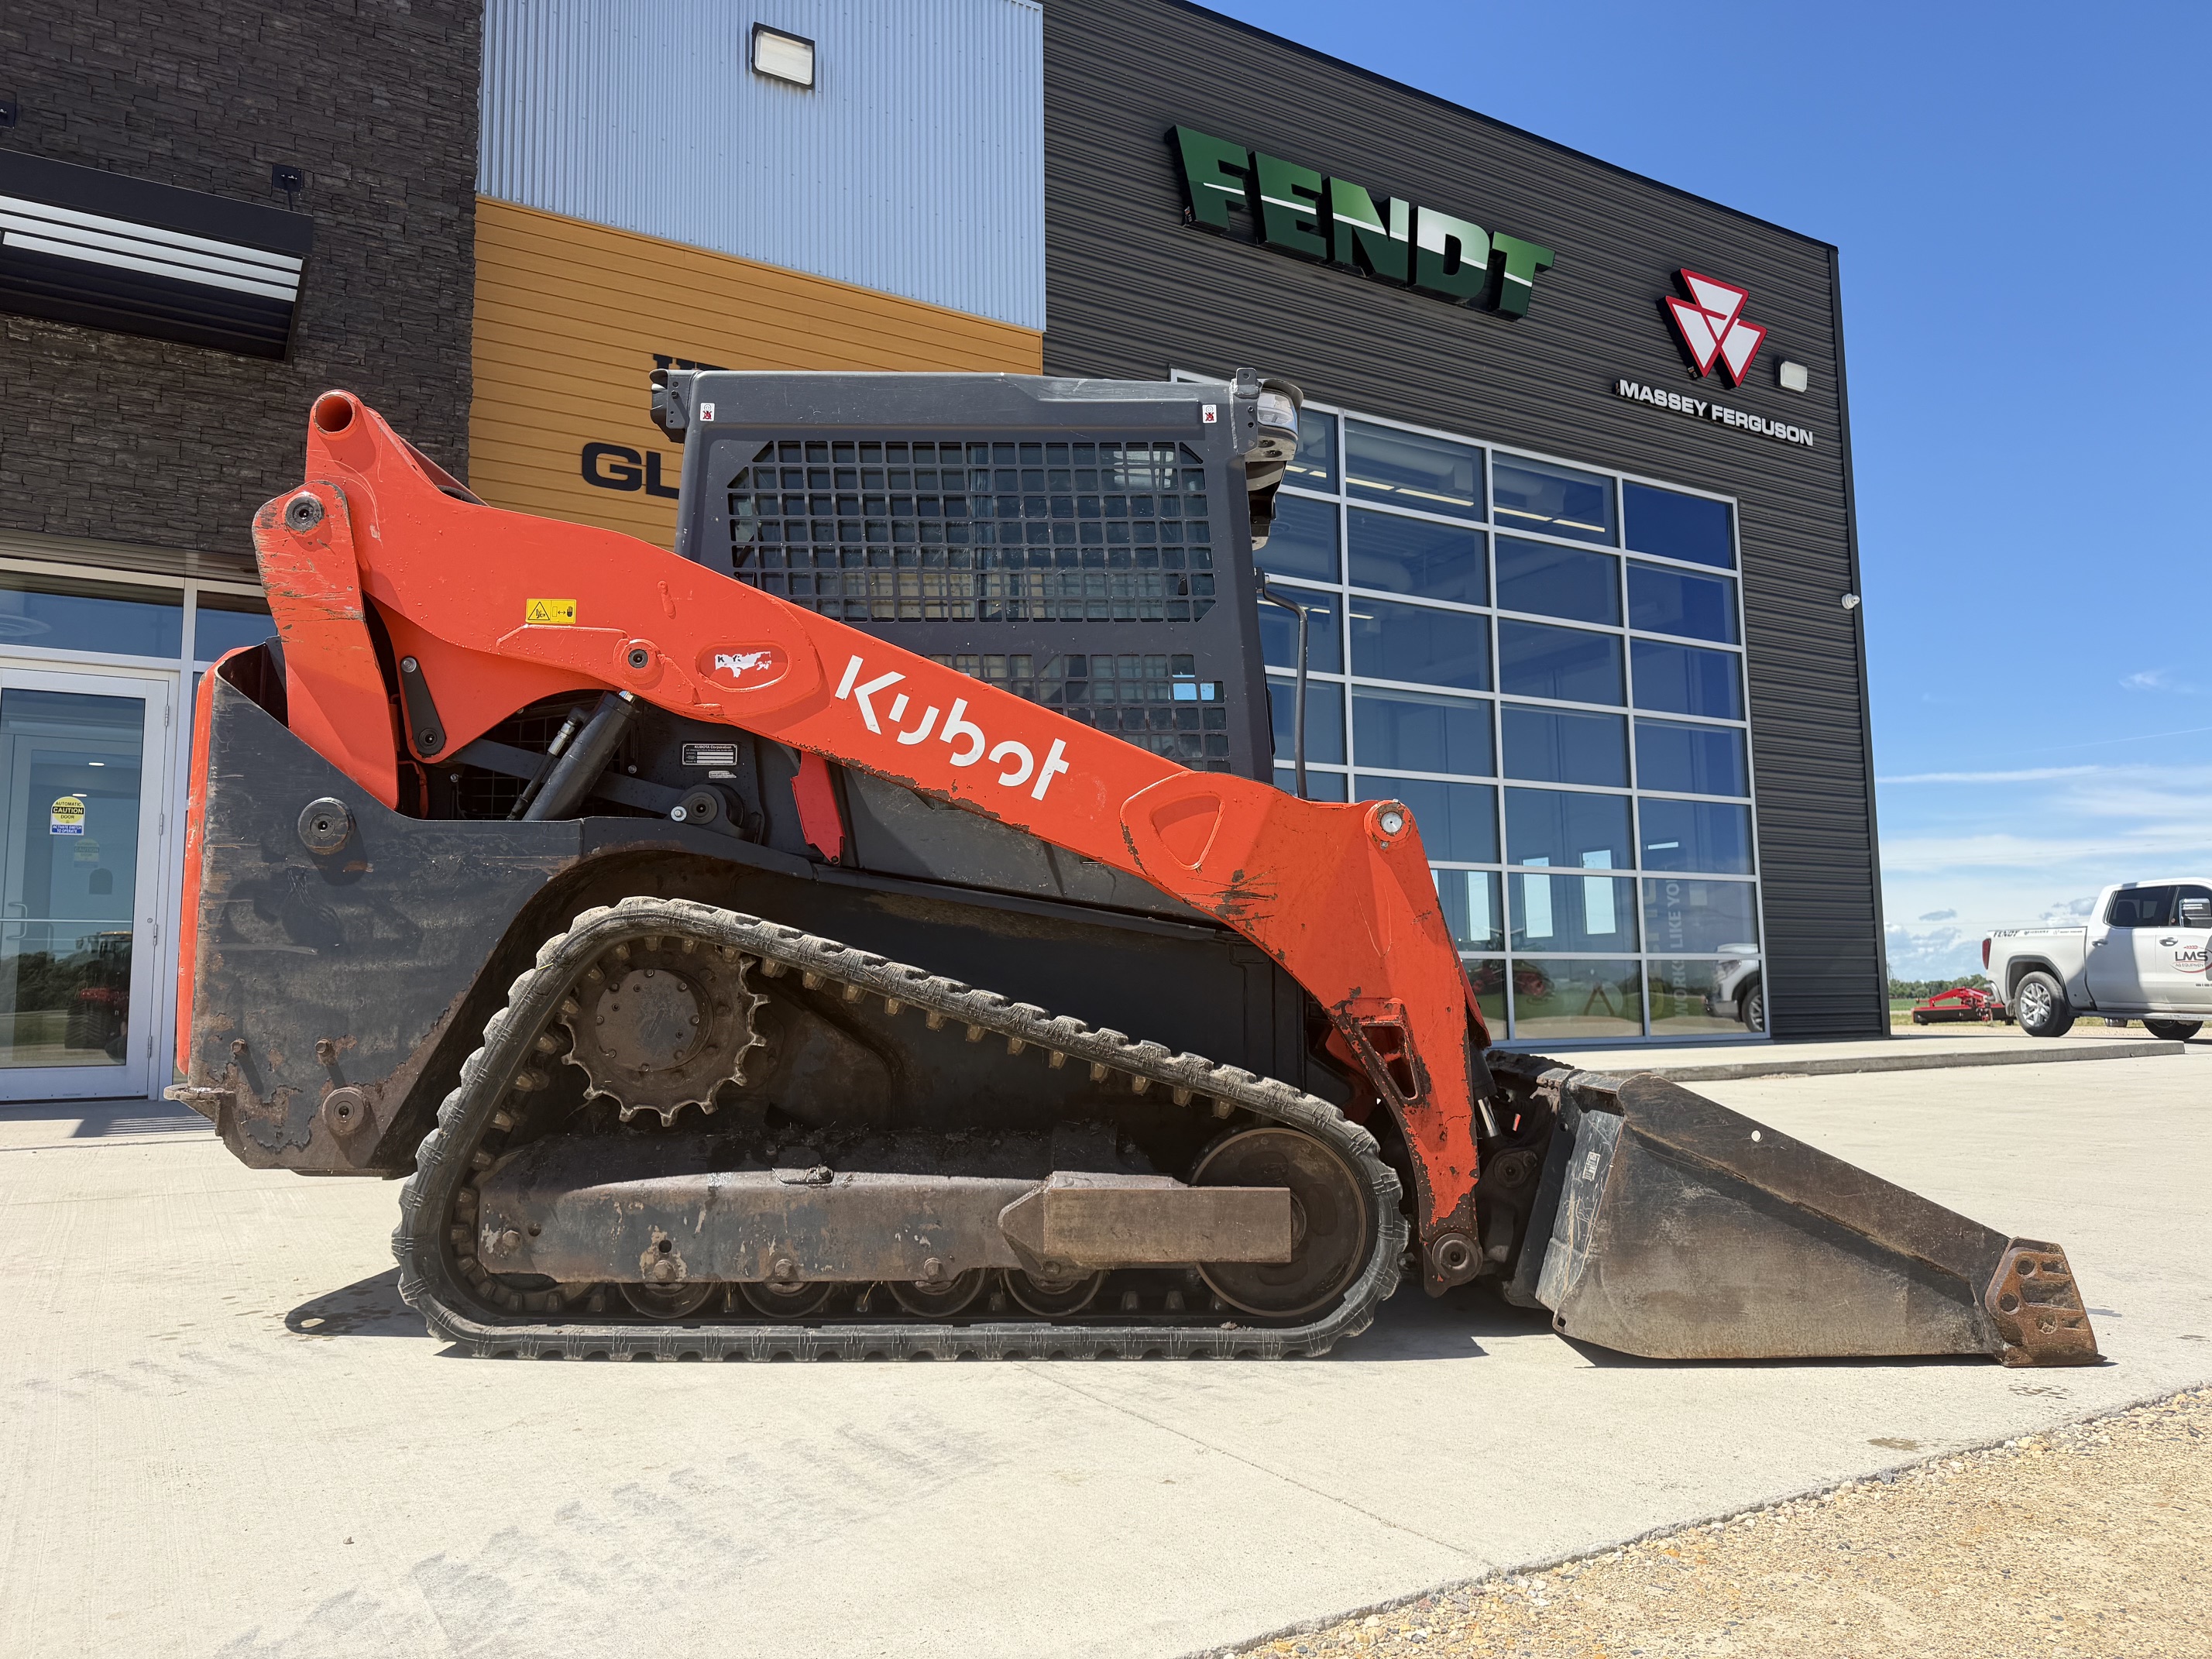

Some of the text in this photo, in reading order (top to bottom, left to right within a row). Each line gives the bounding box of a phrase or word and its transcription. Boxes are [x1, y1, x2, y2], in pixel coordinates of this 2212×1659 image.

[1175, 124, 1555, 318] FENDT
[1619, 379, 1814, 447] MASSEY FERGUSON
[1668, 911, 1683, 948] LIKE
[1993, 929, 2019, 938] FENDT
[2175, 951, 2209, 962] LMS
